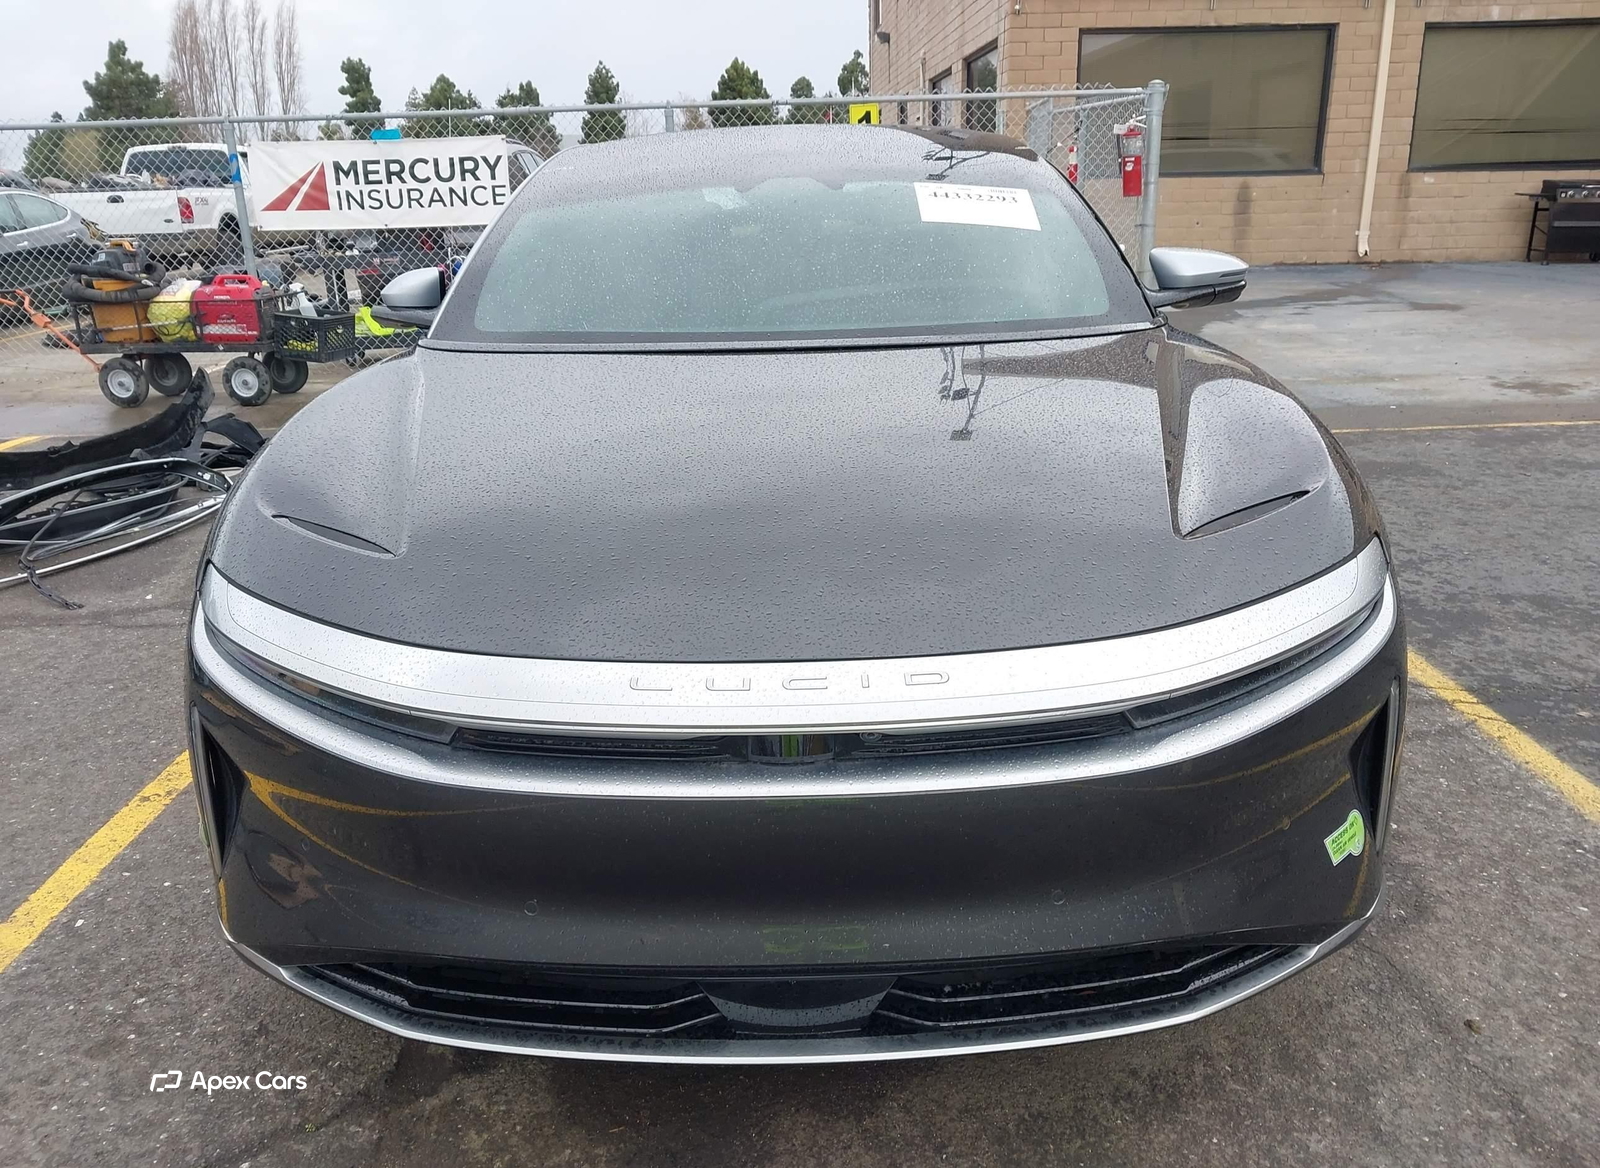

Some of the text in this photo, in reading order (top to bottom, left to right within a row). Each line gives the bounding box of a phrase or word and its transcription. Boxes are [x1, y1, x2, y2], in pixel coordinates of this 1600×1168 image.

[332, 155, 503, 186] MERCURY
[336, 185, 506, 211] INSURANCE
[928, 191, 1018, 204] 44332293
[629, 671, 950, 692] LUCID
